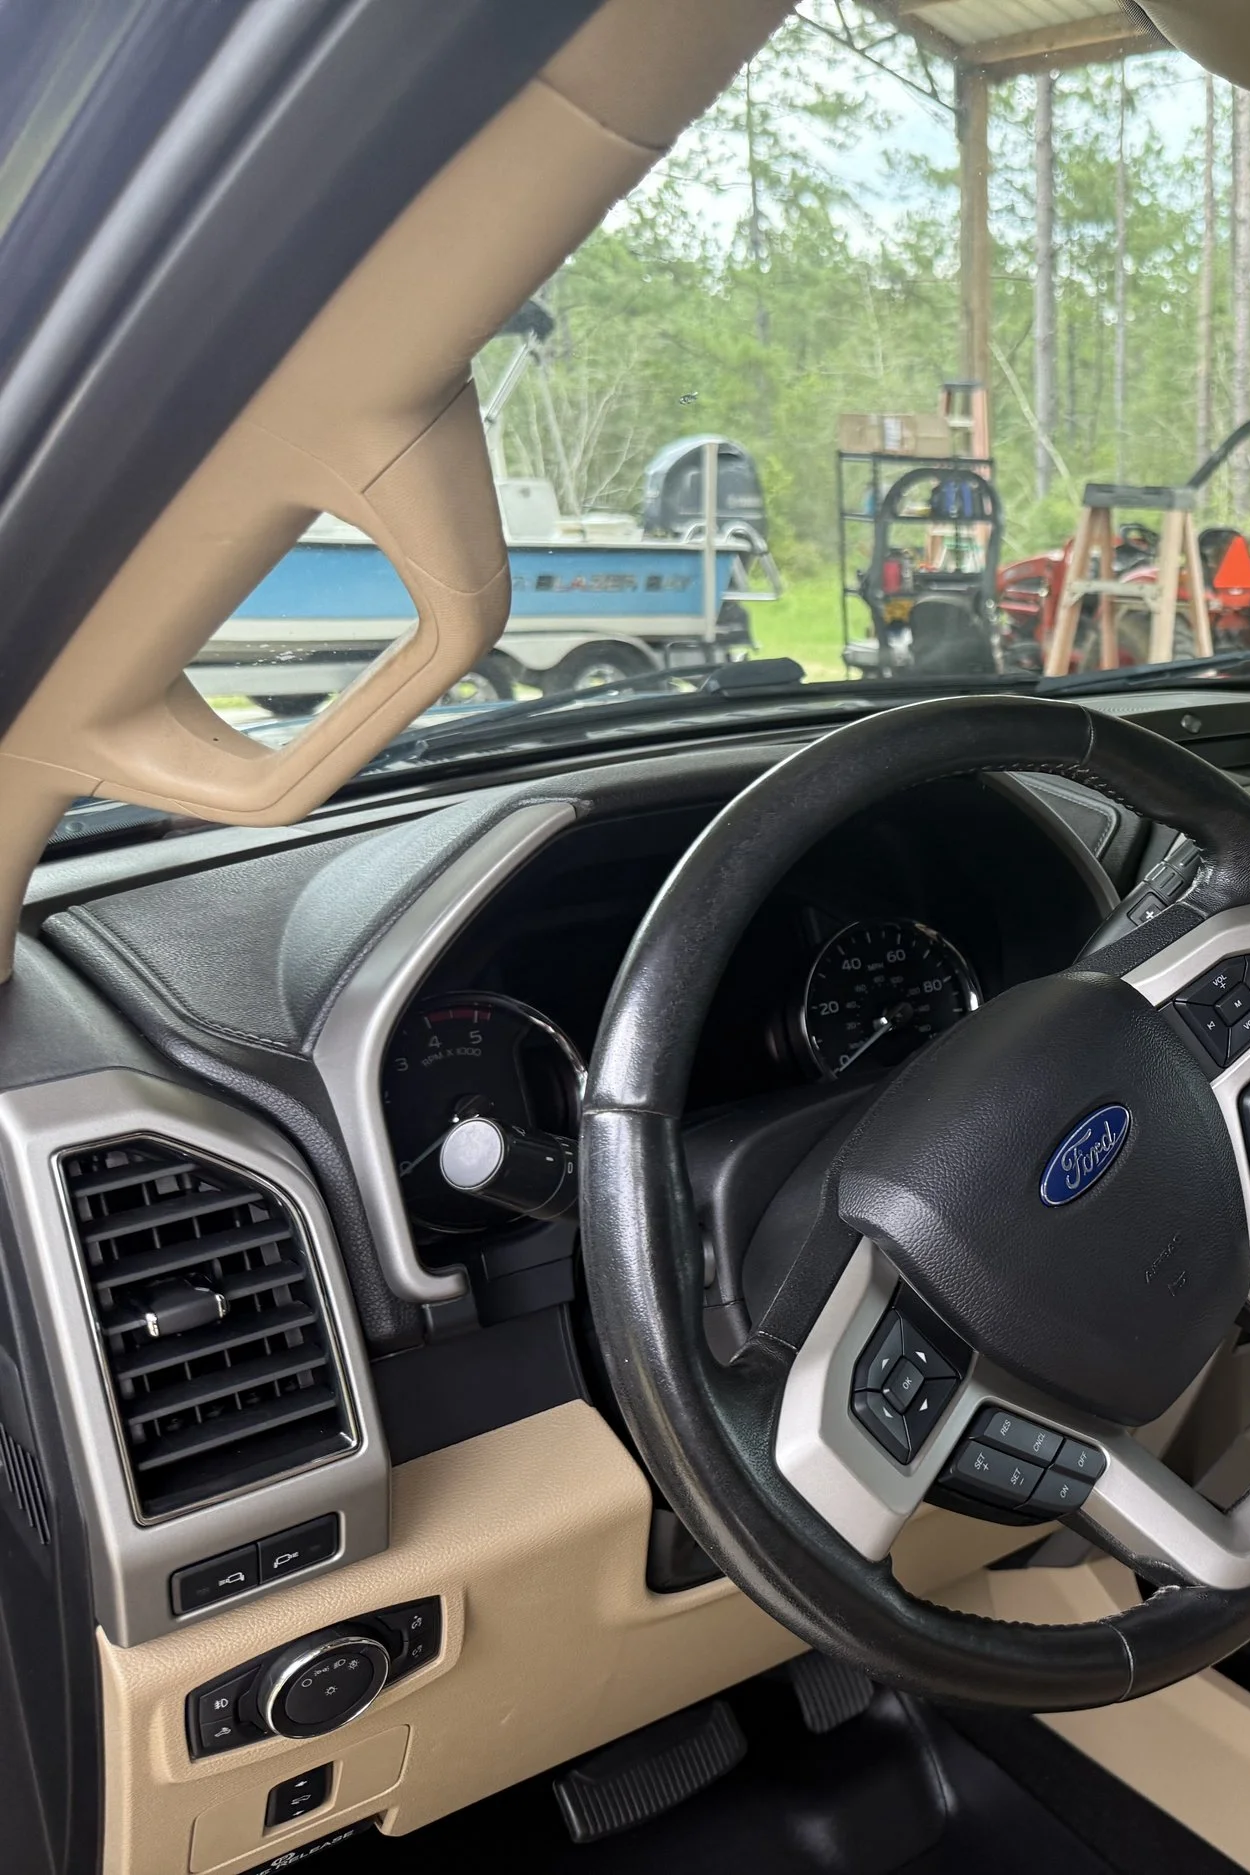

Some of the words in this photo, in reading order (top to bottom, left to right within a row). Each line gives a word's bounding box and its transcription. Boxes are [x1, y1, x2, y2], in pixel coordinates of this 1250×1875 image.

[886, 948, 907, 964] 60
[841, 957, 862, 972] 40
[923, 978, 943, 994] 80
[1212, 974, 1227, 986] VOL
[819, 1000, 840, 1016] 20
[1234, 1000, 1242, 1008] M
[428, 1035, 442, 1049] 4
[469, 1030, 484, 1045] 5
[394, 1057, 409, 1072] 3
[421, 1050, 444, 1068] RPM
[456, 1047, 483, 1058] 1000
[1061, 1120, 1118, 1190] Ford
[902, 1376, 914, 1390] OK
[999, 1418, 1012, 1437] RES
[1032, 1431, 1046, 1453] CNCL
[973, 1451, 987, 1471] SET
[1077, 1450, 1089, 1468] OFF
[1010, 1467, 1023, 1485] SET
[1058, 1483, 1070, 1499] ON
[275, 1829, 355, 1871] RELEASE
